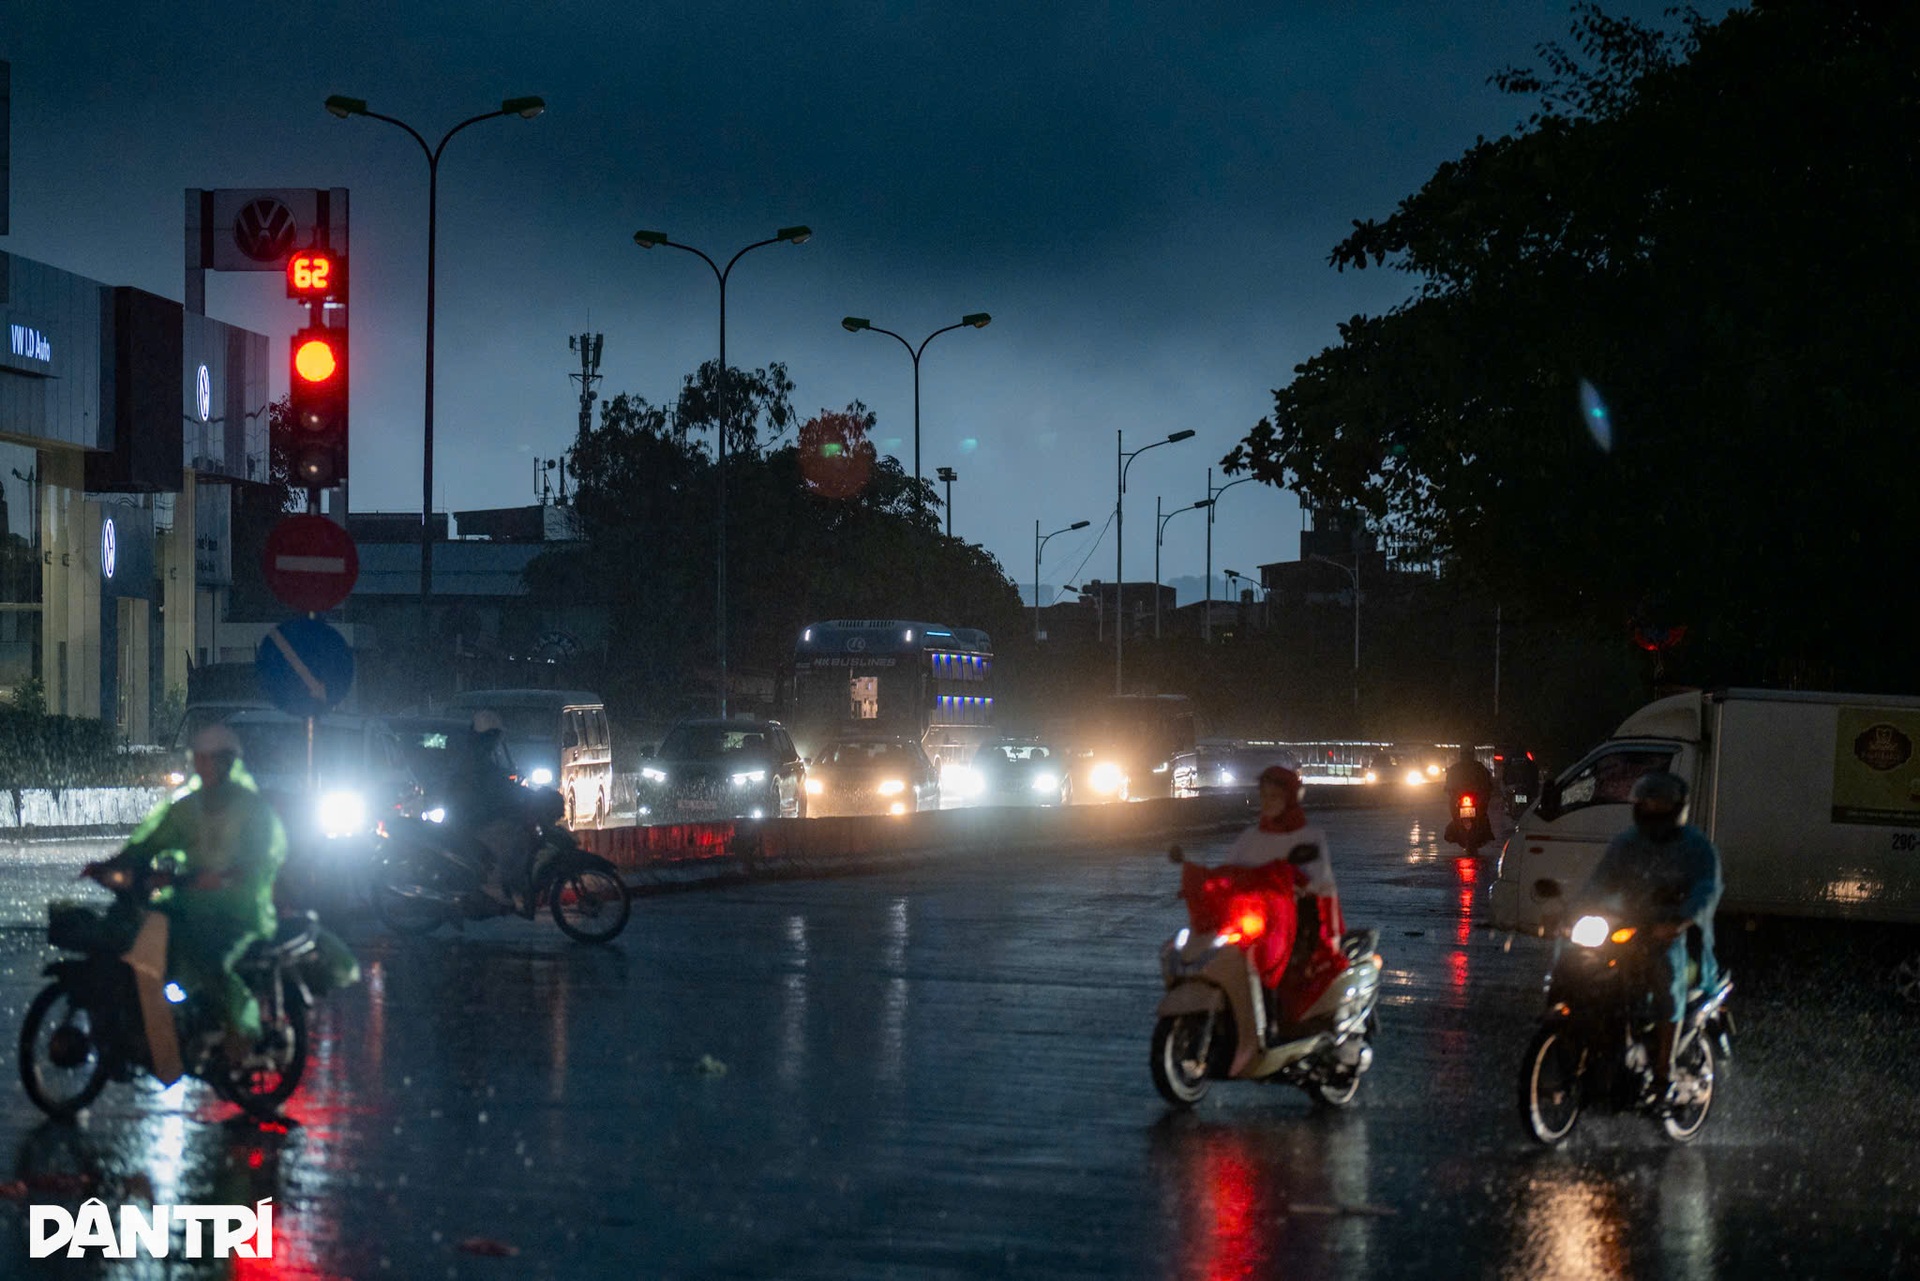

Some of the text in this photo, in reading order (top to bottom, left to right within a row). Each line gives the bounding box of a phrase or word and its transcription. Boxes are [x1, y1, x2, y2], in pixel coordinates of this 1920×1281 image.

[294, 258, 329, 288] 62
[11, 324, 24, 355] VW
[35, 330, 51, 362] Auto
